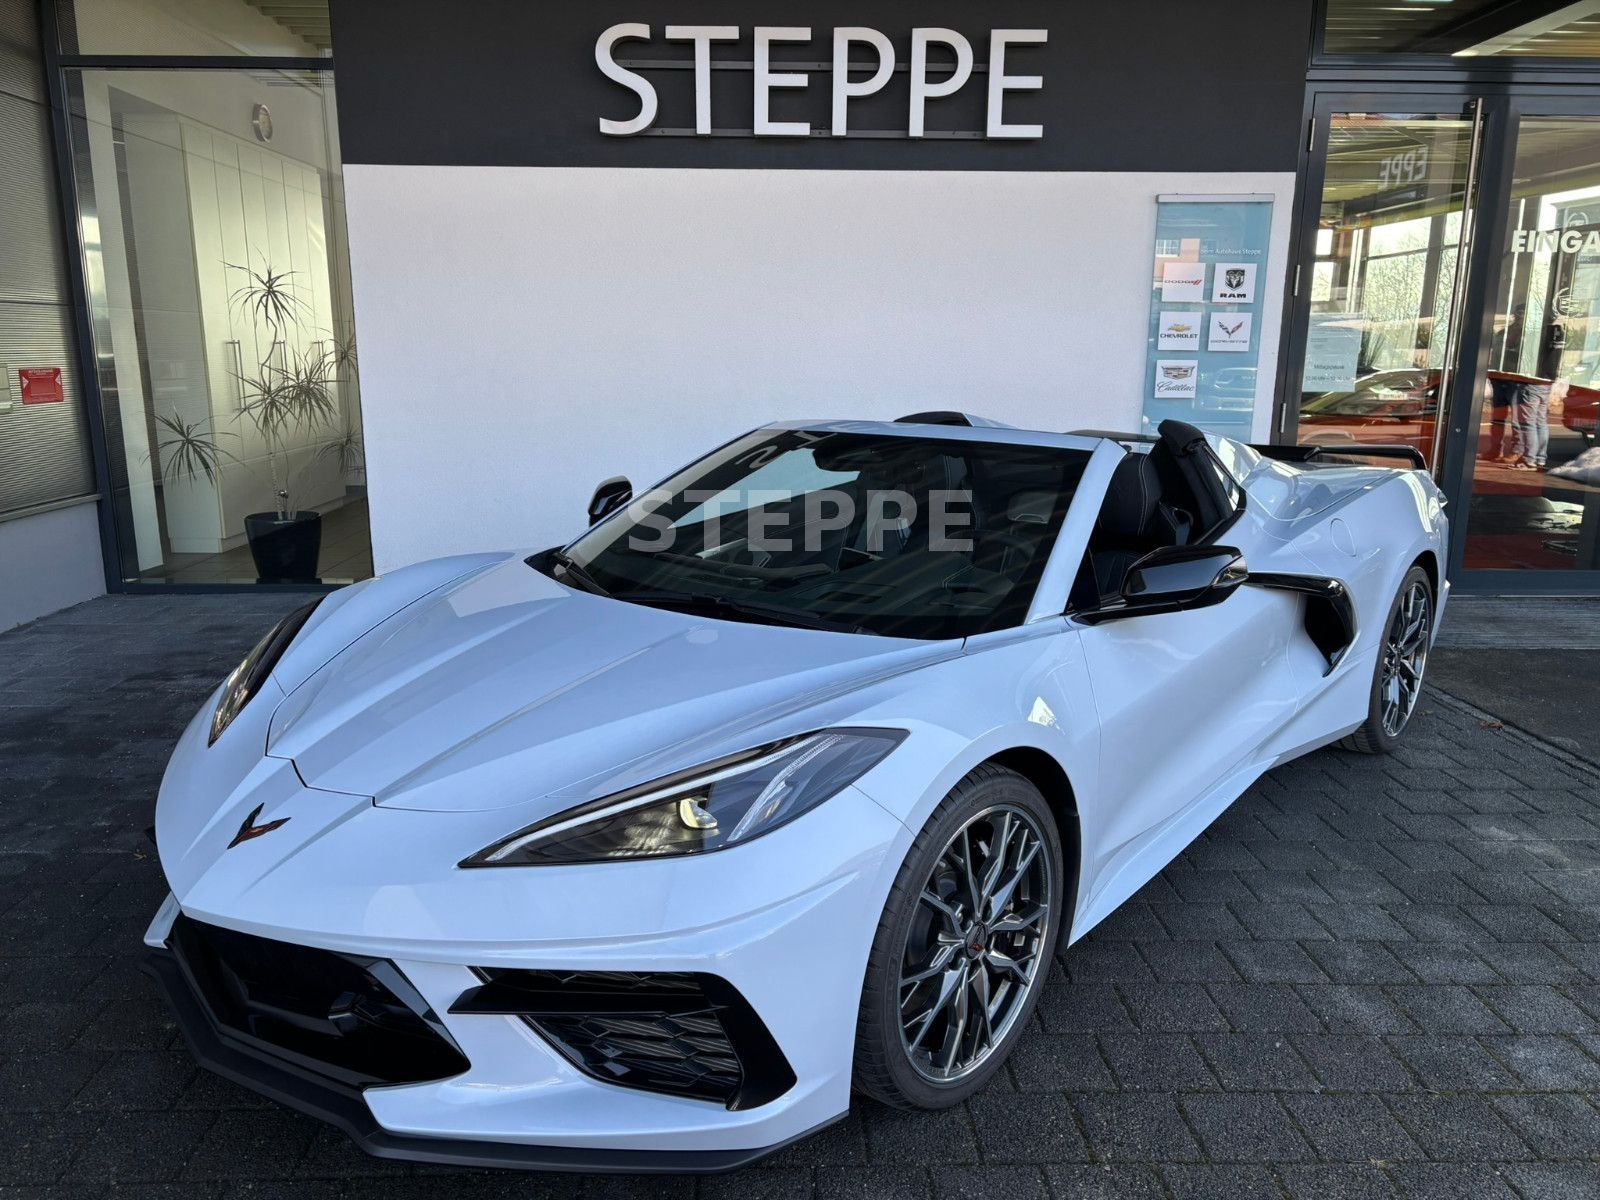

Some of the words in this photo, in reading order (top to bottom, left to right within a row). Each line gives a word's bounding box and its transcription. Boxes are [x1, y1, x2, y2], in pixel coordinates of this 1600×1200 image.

[595, 22, 1049, 138] STEPPE
[1511, 229, 1600, 254] EINGA
[1156, 380, 1195, 393] Cadillac
